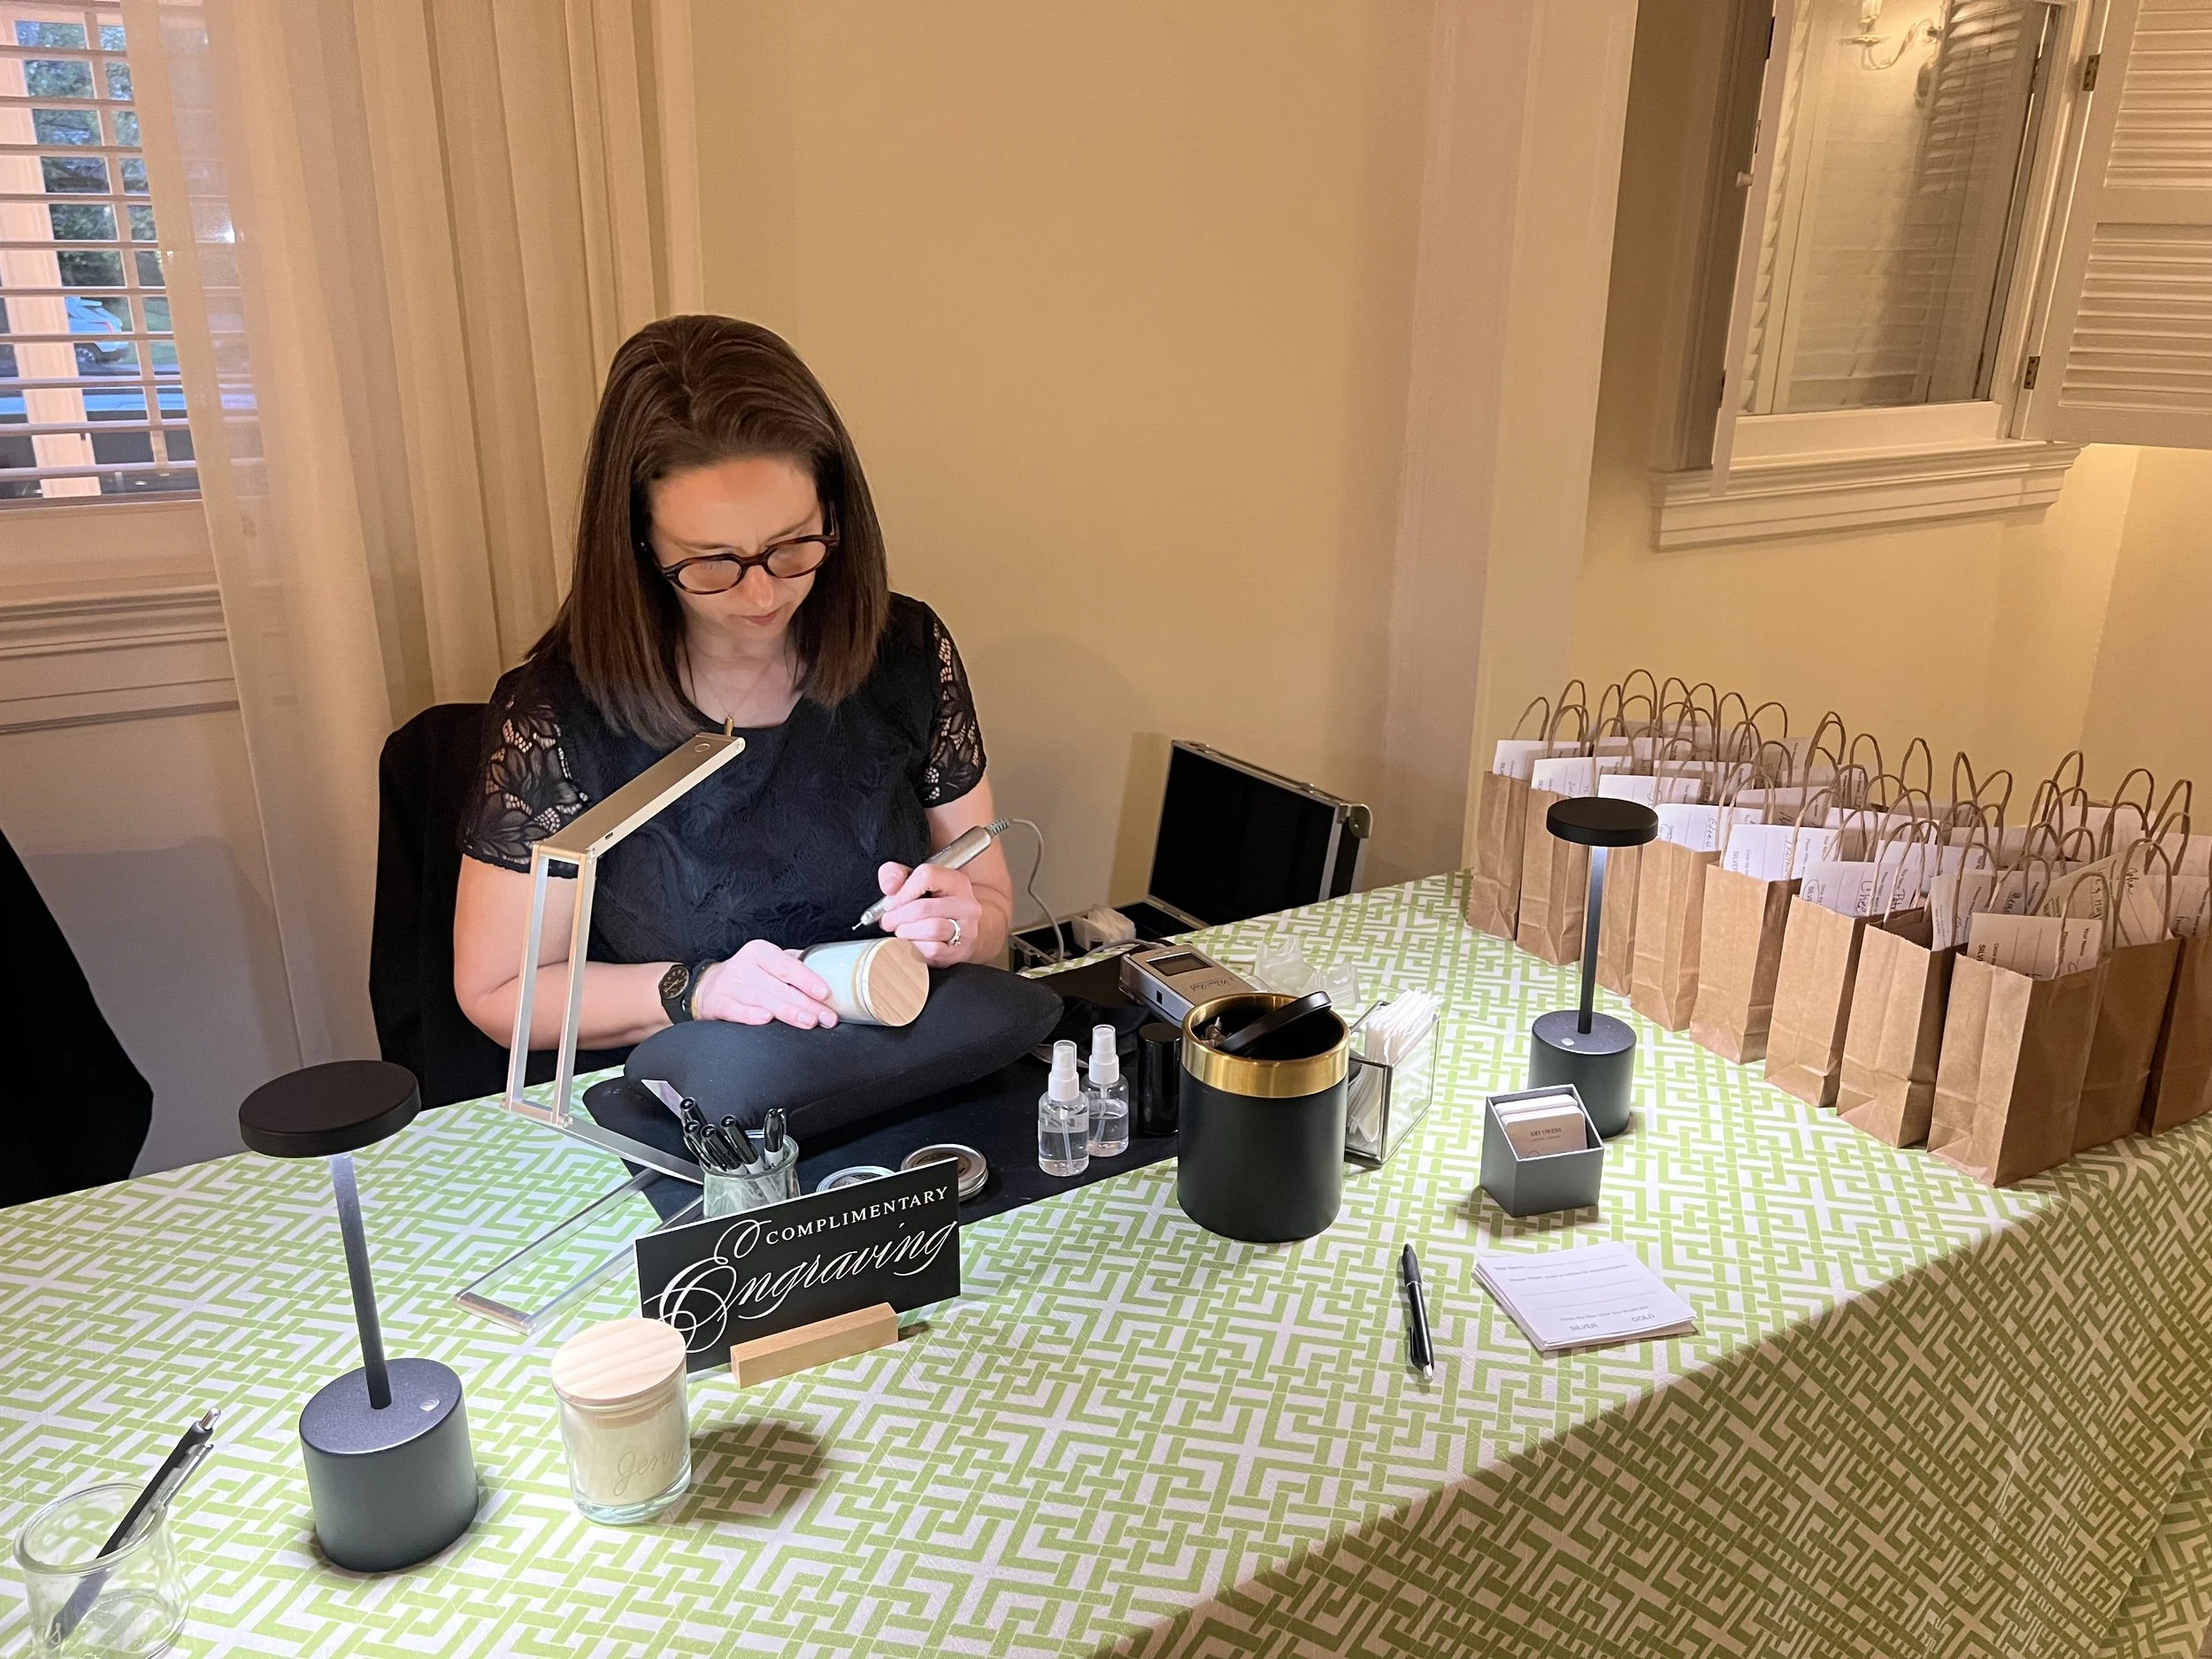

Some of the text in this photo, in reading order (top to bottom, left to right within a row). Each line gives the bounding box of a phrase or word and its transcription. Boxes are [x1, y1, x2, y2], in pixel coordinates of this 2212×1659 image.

[1977, 944, 1985, 961] SILV
[765, 1186, 948, 1245] COMPLIMENTARY
[643, 1218, 958, 1353] Engraving
[1631, 1313, 1655, 1323] GOLD
[1570, 1323, 1598, 1332] SILVER
